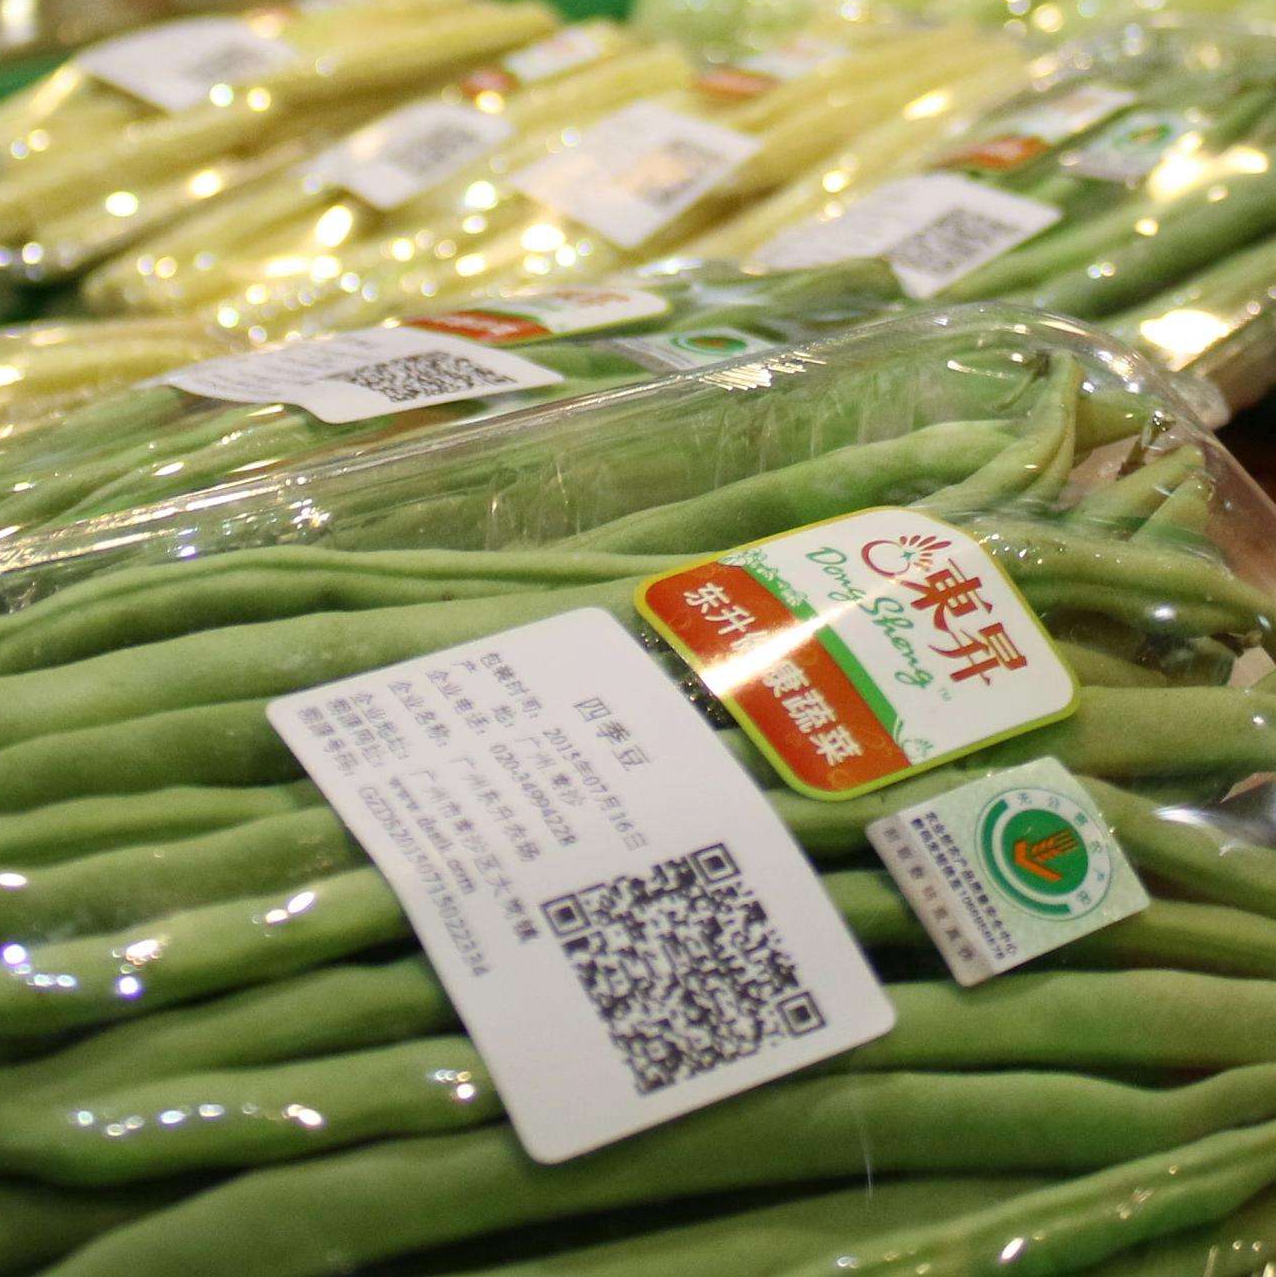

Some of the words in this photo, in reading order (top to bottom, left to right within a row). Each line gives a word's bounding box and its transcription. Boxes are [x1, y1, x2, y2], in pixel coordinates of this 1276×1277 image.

[683, 582, 865, 767] 东升康蔬菜
[805, 547, 866, 602] Dong
[857, 597, 934, 689] Sheng
[574, 696, 650, 771] 四季豆
